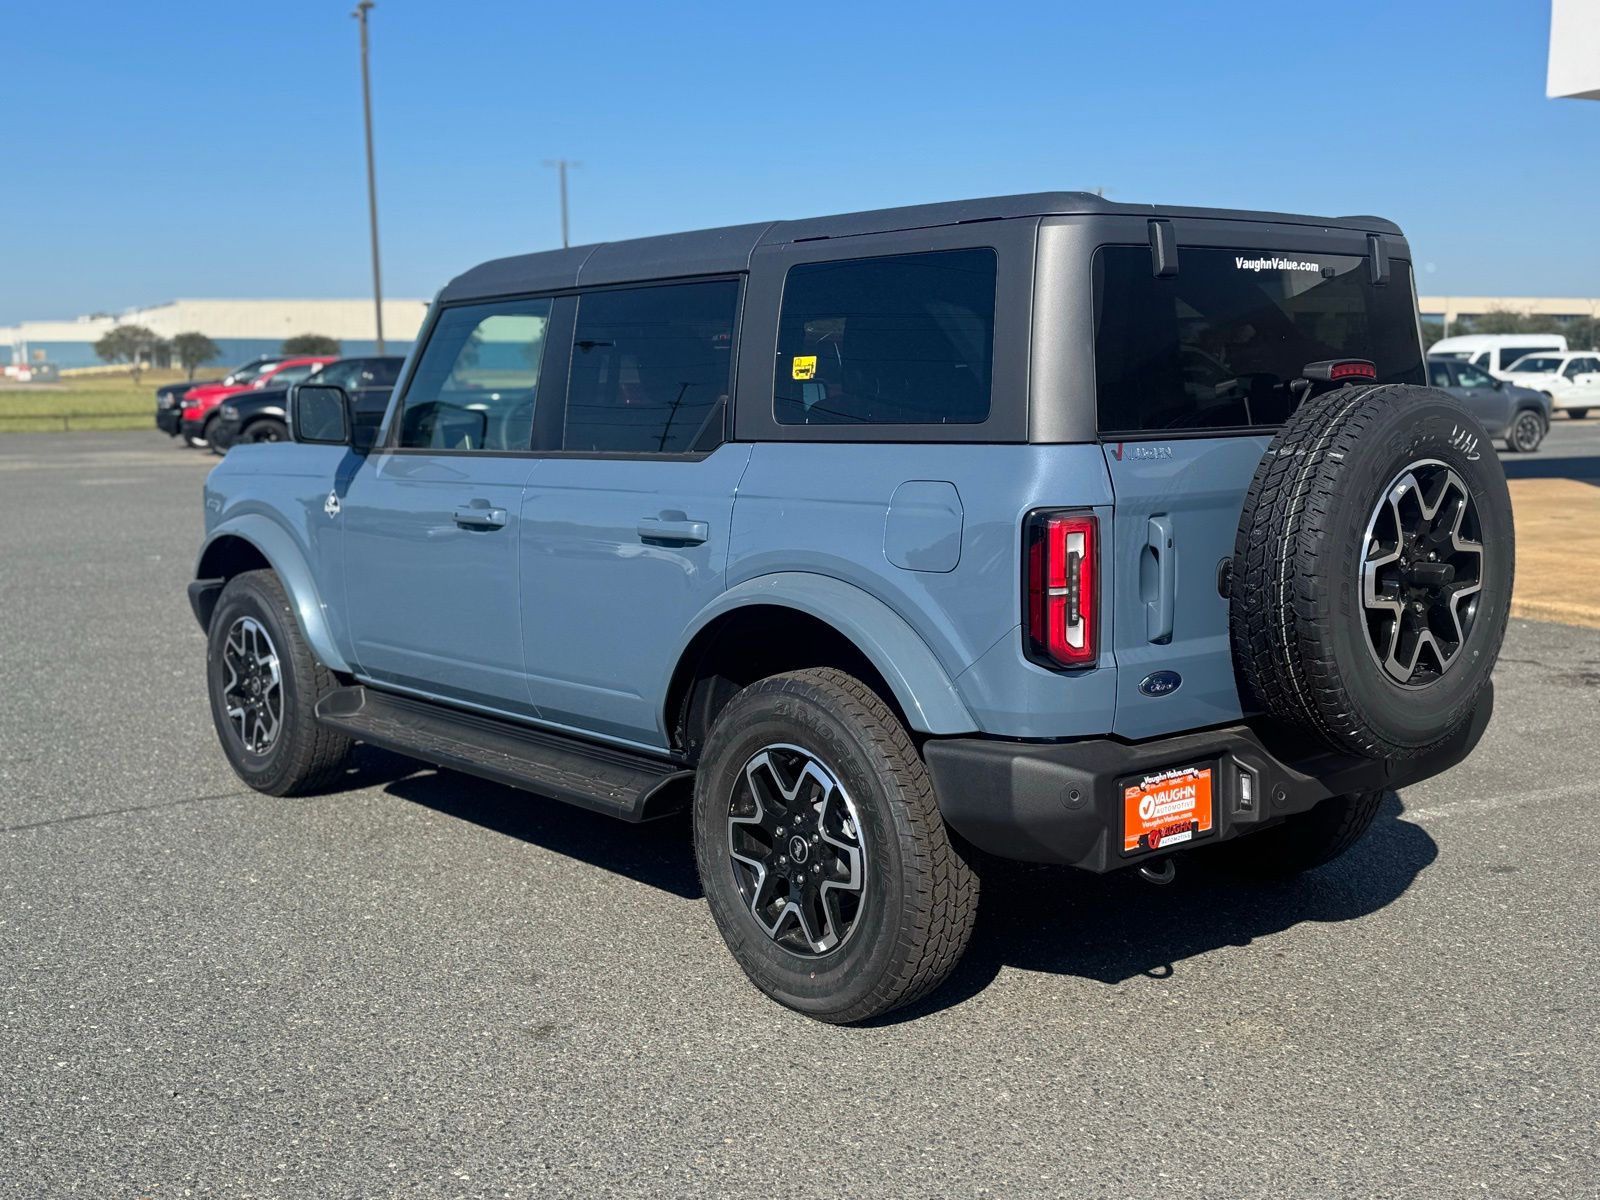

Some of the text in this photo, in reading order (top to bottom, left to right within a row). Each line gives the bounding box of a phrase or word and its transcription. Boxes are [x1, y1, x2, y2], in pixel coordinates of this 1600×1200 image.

[1235, 256, 1319, 272] VaughnValue.com
[1153, 784, 1196, 805] VAUGHN
[1156, 799, 1194, 815] AUTOMOTIVE
[1160, 821, 1193, 836] VAUGHN
[1161, 832, 1191, 845] AUTOMOTIVE
